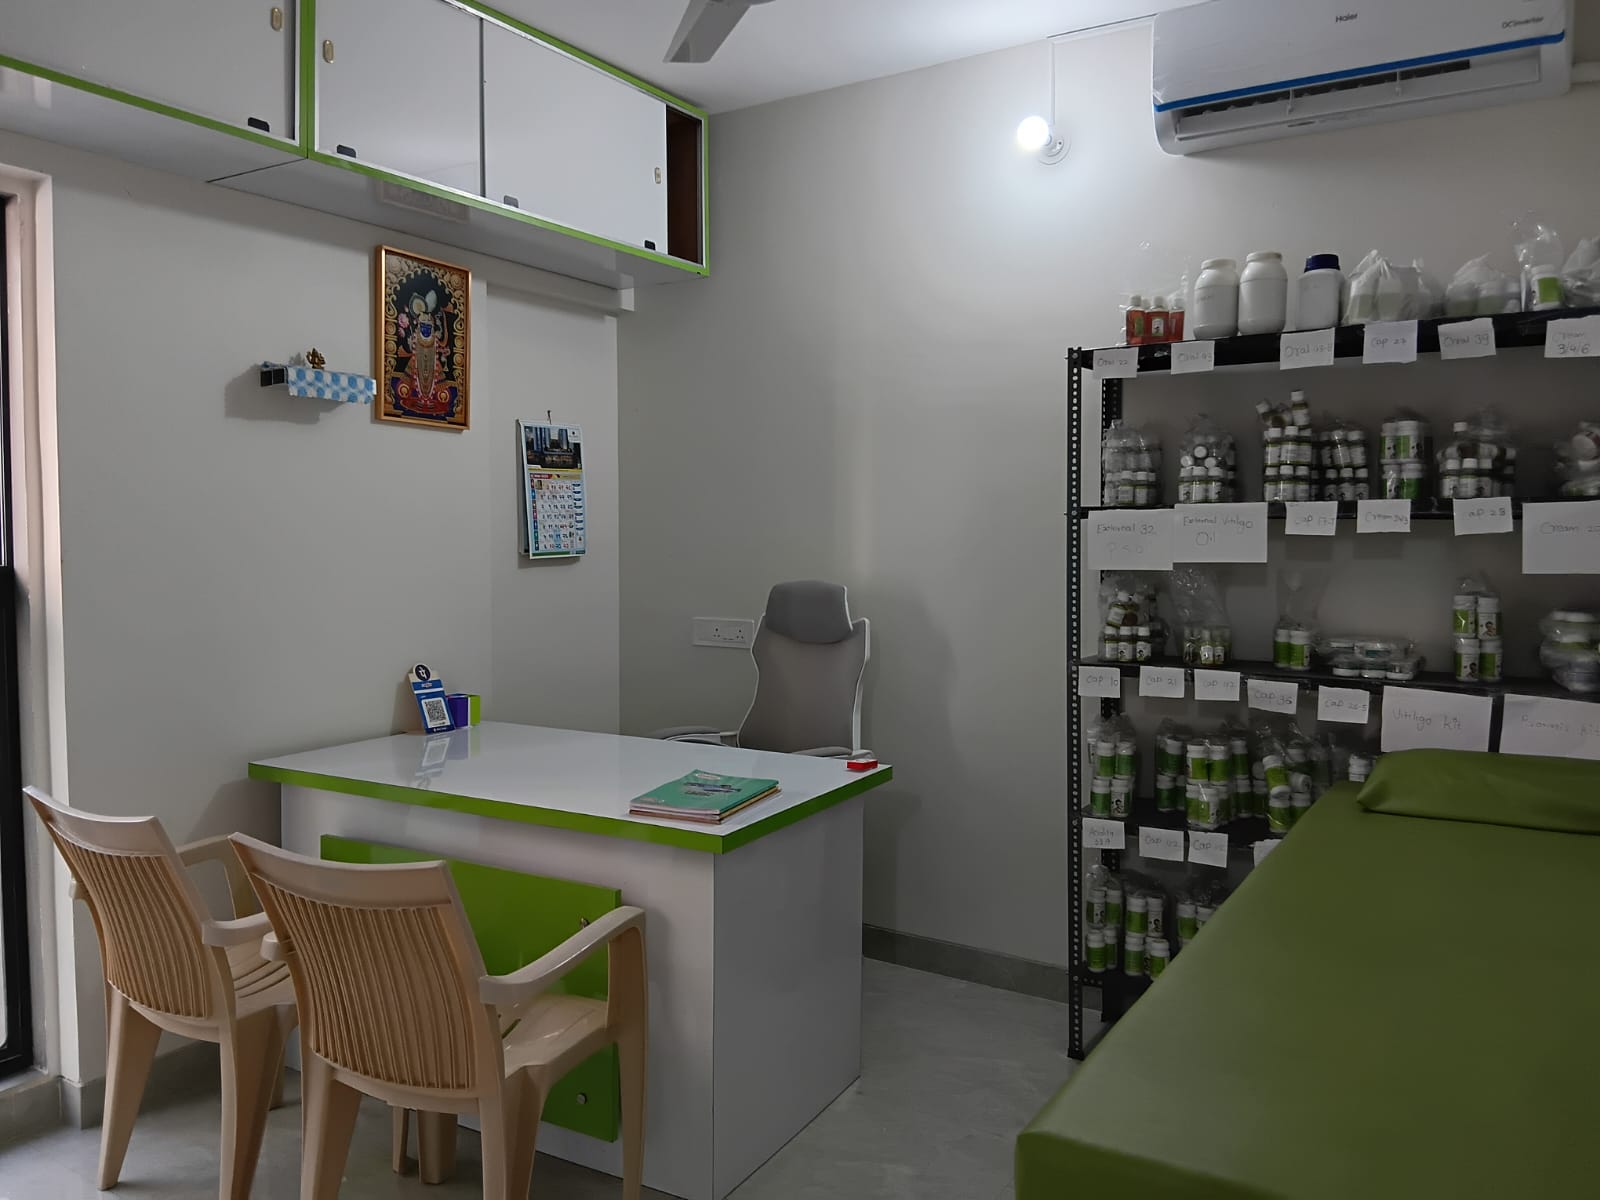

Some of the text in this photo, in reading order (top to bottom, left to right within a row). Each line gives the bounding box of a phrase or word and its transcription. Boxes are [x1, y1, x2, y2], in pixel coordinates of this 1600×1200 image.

[1335, 12, 1358, 24] Haier
[1370, 336, 1389, 349] Cap
[1284, 343, 1311, 358] Oral
[1096, 356, 1115, 368] Oral
[1183, 513, 1217, 528] External
[1540, 520, 1580, 535] Cream
[1096, 522, 1136, 536] External
[1255, 690, 1276, 704] Cap
[1192, 839, 1212, 851] Cap
